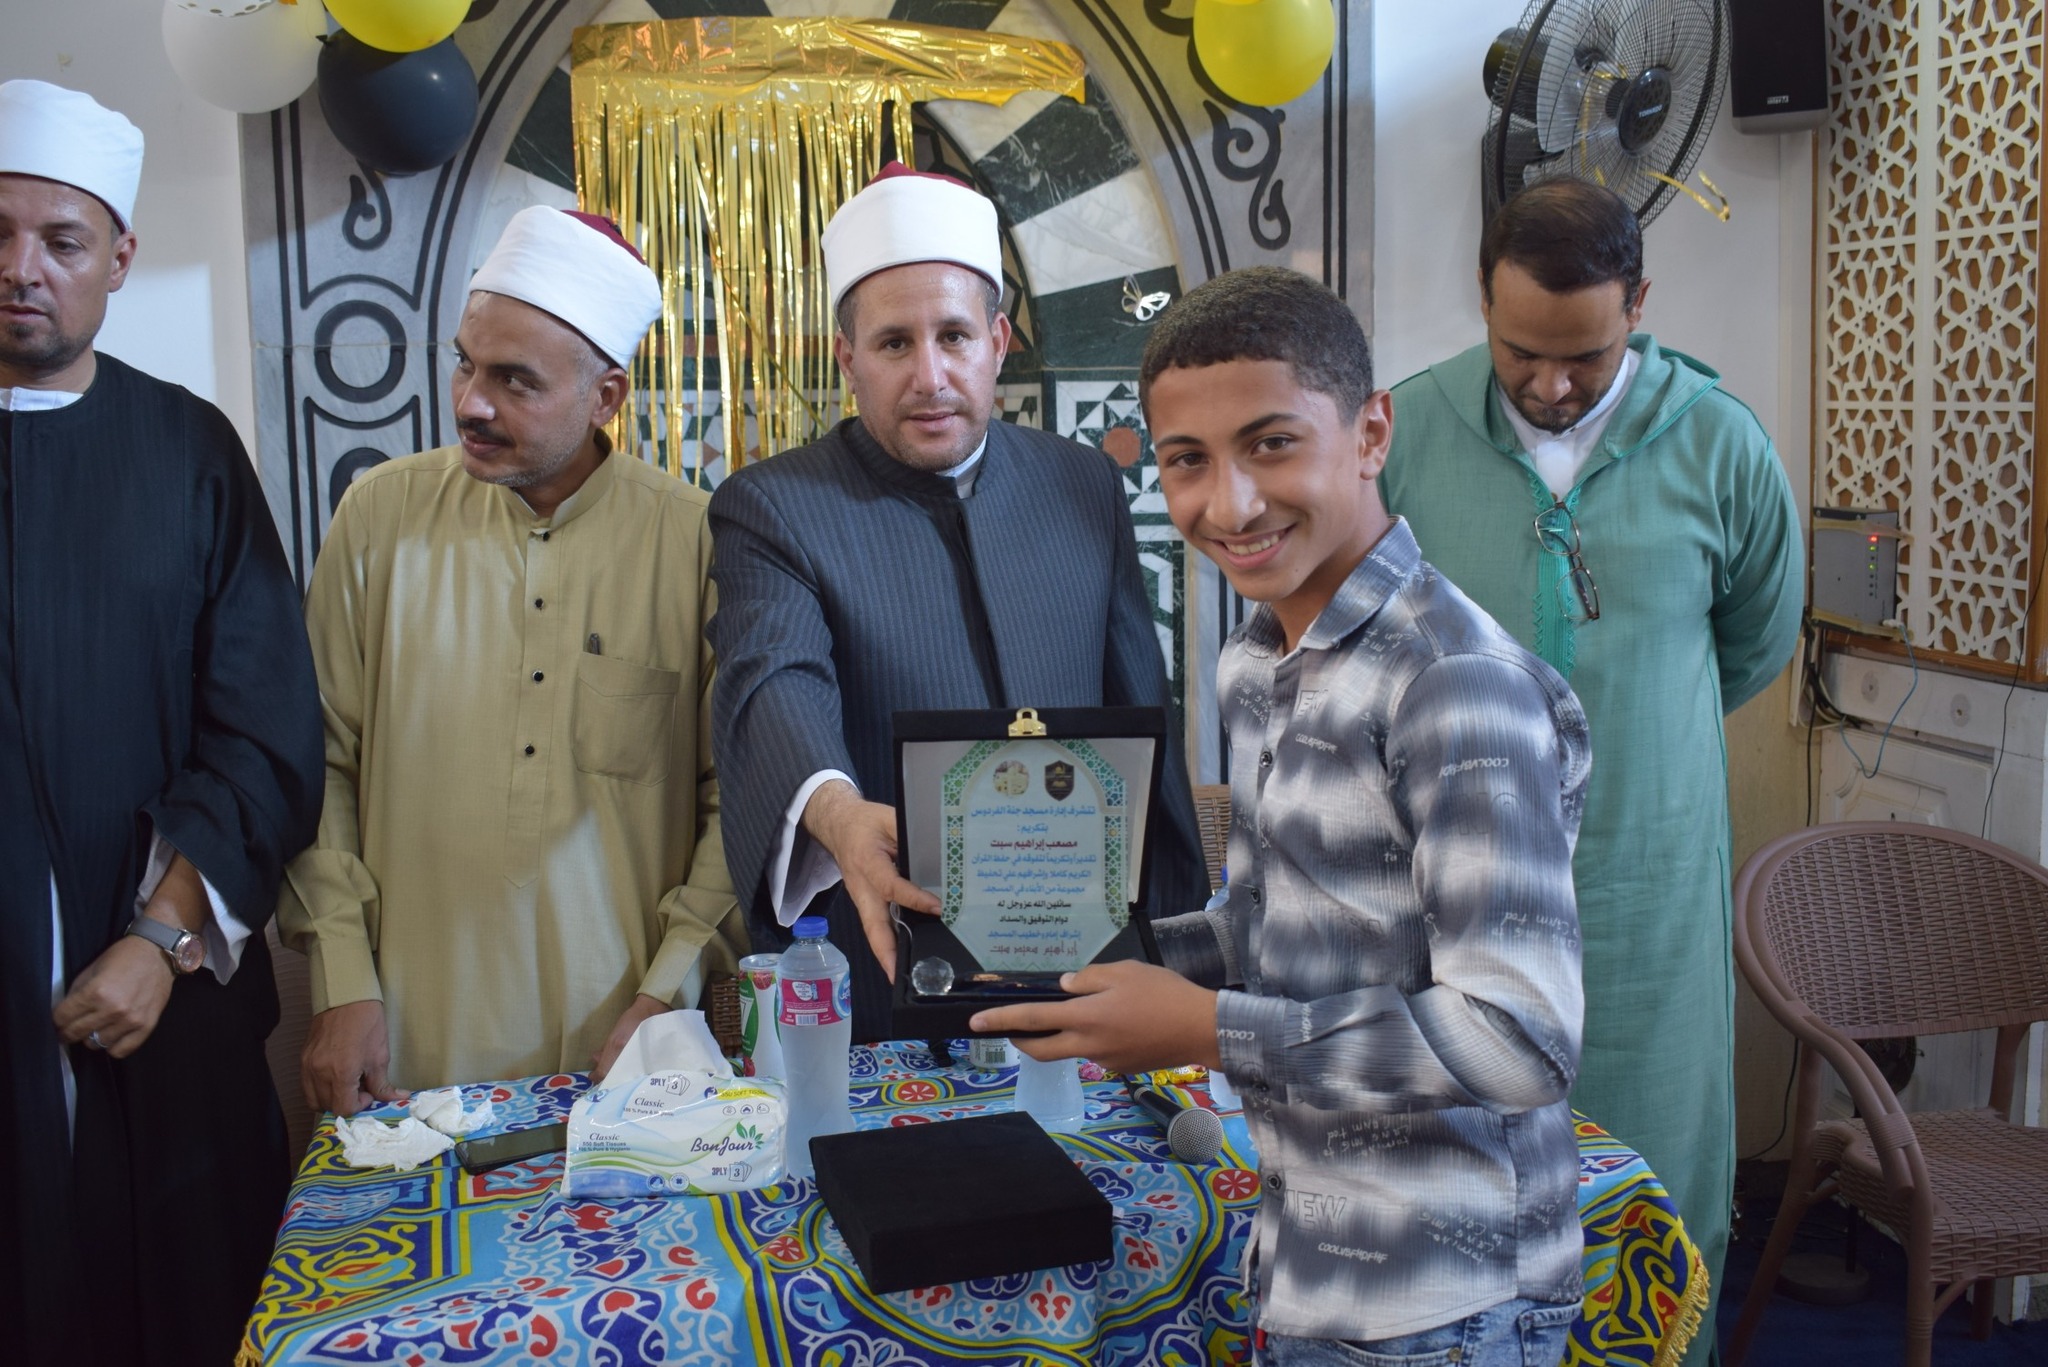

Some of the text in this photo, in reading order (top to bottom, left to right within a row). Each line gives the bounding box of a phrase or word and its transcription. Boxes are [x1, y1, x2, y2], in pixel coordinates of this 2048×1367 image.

[1022, 806, 1049, 816] مسجد
[1014, 839, 1045, 851] إبراهيم
[1046, 840, 1078, 850] مصعب
[650, 1077, 667, 1087] 3PLY
[634, 1097, 665, 1108] Classic
[589, 1132, 620, 1140] Classic
[690, 1136, 754, 1156] BonJour
[712, 1166, 741, 1177] 3PLY 3
